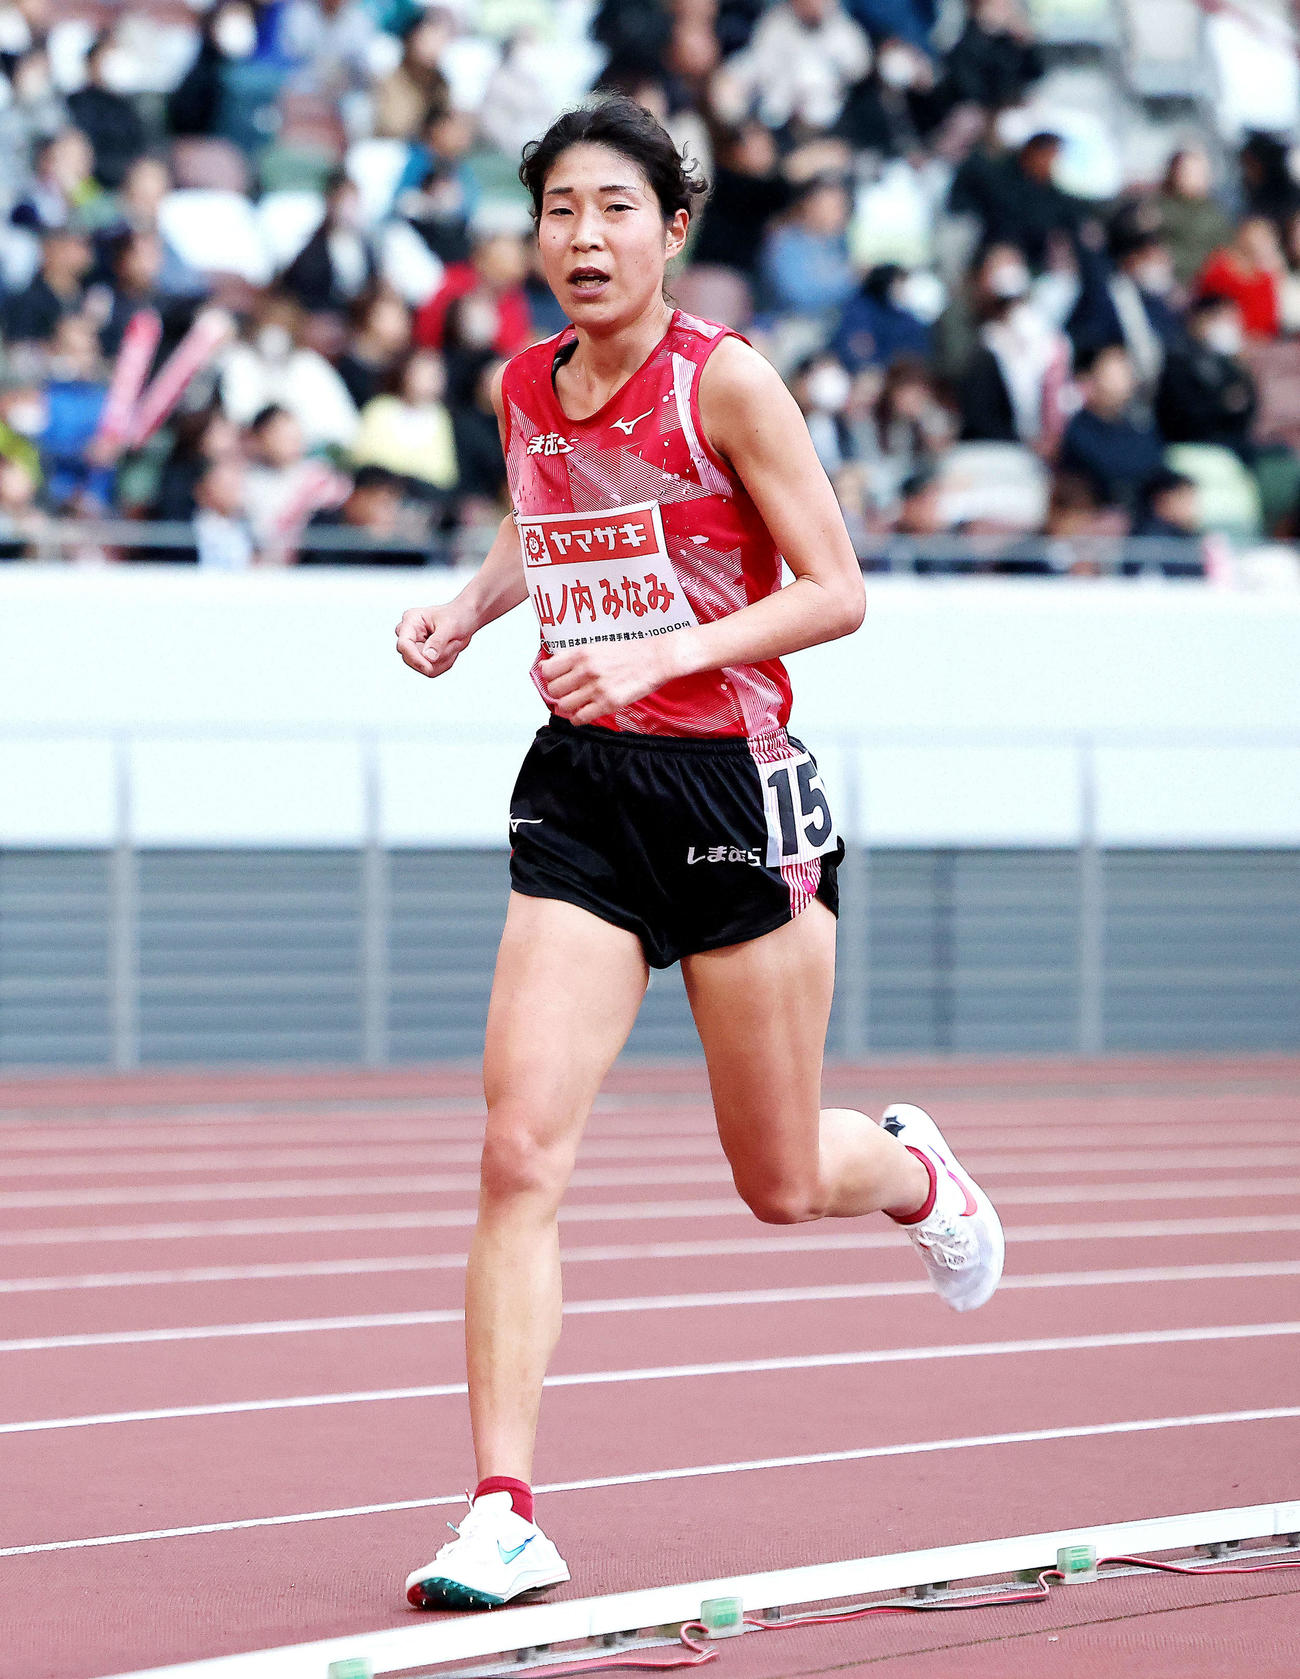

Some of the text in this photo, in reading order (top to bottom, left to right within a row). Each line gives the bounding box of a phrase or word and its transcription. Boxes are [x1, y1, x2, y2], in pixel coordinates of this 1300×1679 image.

[550, 522, 647, 555] ヤマザキ
[533, 573, 675, 627] 山ノ内 みなみ
[767, 761, 832, 857] 15
[687, 846, 762, 867] しまむら
